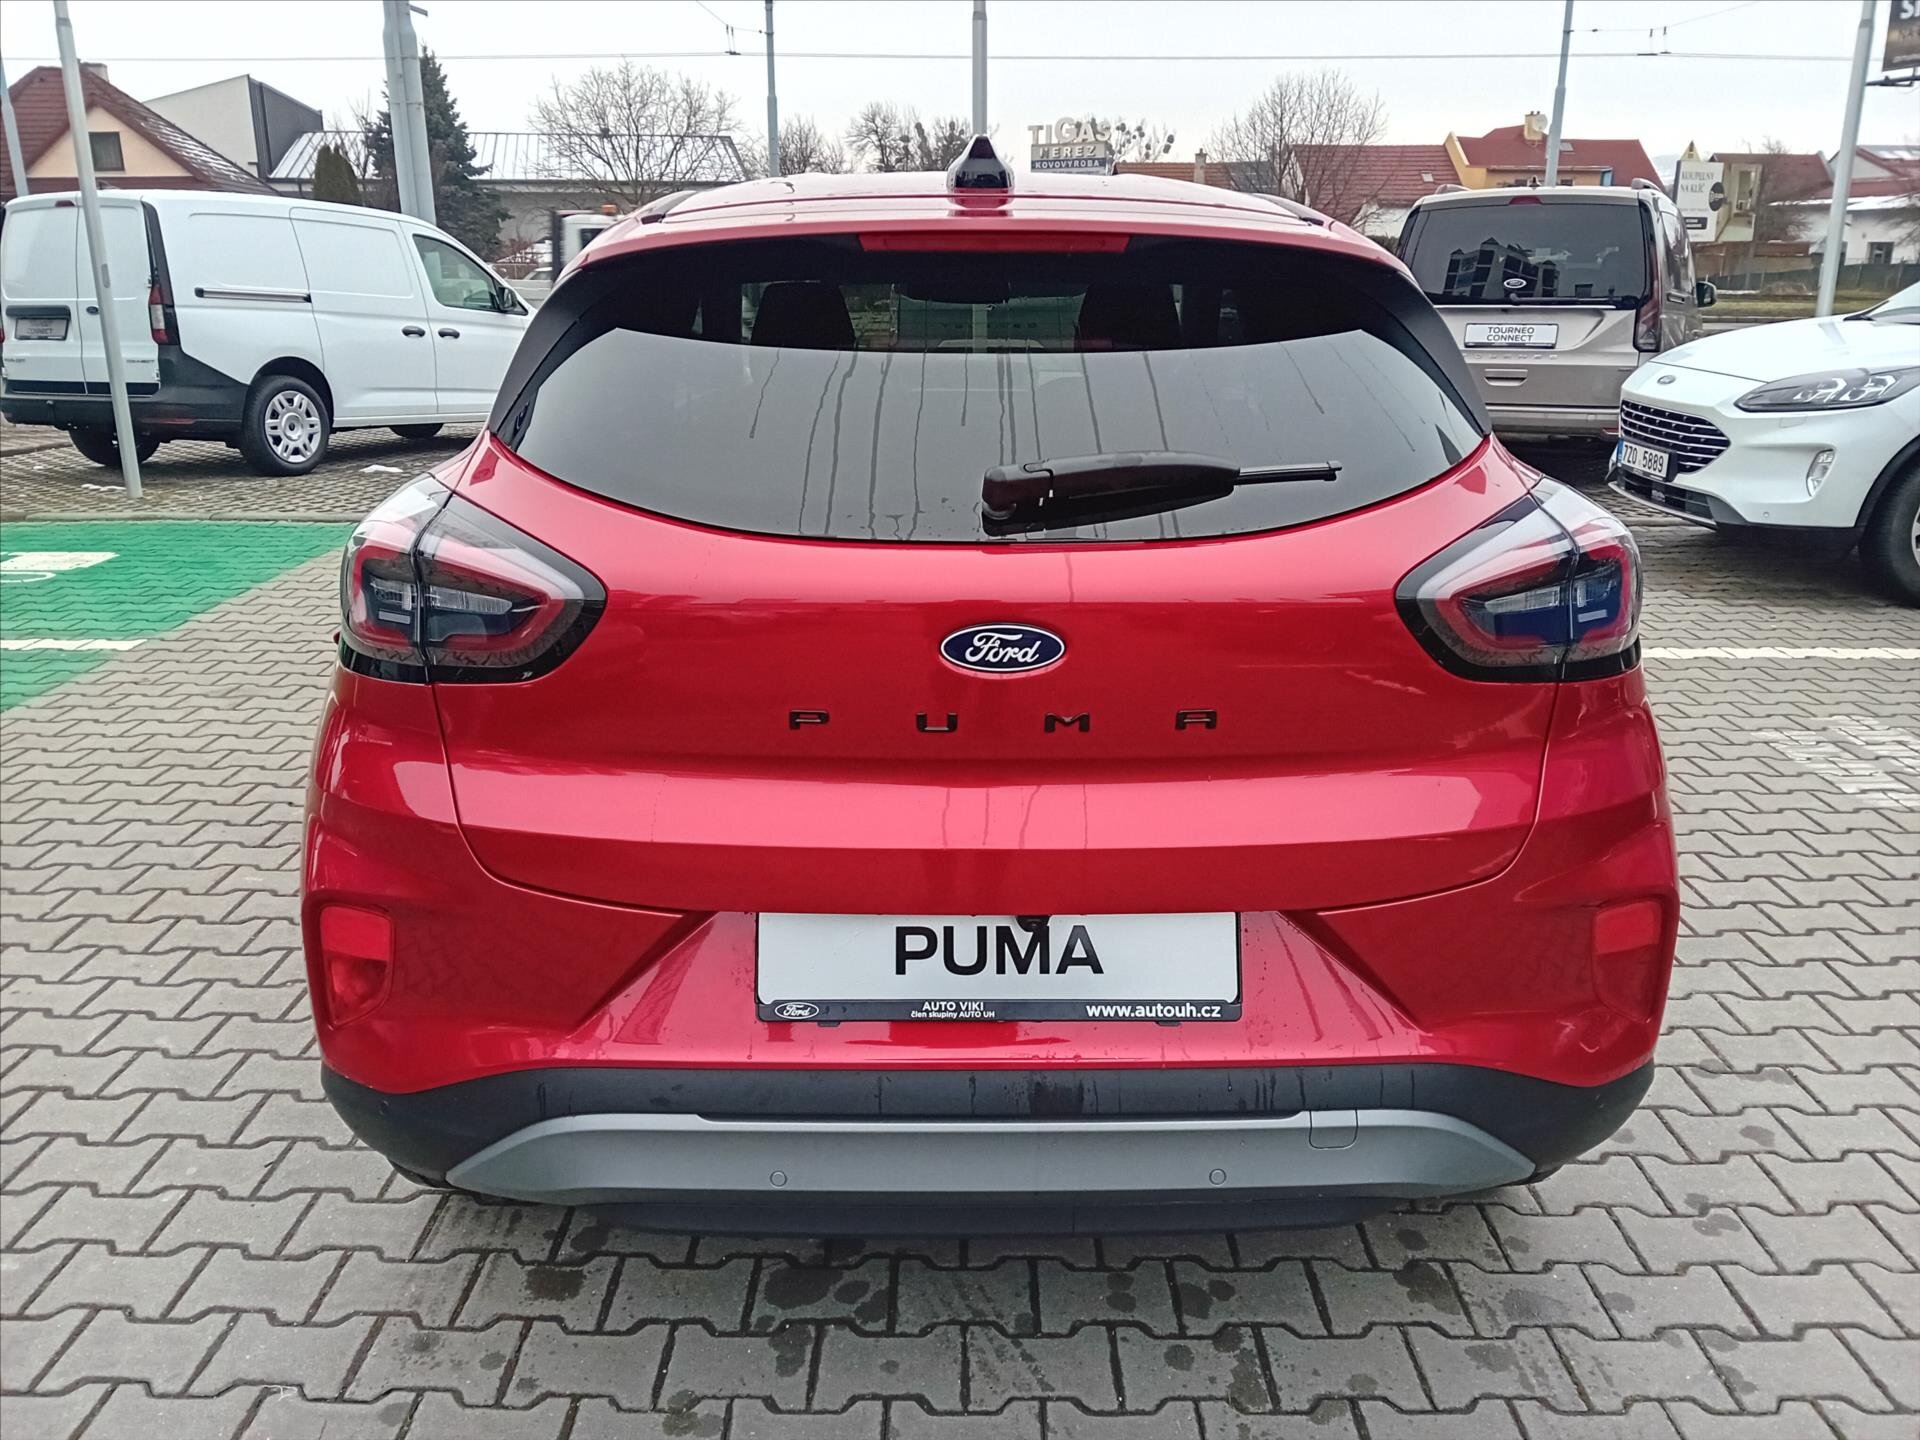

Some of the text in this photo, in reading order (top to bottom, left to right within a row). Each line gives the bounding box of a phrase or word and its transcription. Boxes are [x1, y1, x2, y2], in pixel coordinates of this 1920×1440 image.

[1028, 117, 1111, 144] TIGAS
[1041, 146, 1096, 158] NEREZ
[1488, 326, 1535, 334] TOURNEO
[1487, 334, 1534, 342] CONNECT
[1642, 450, 1664, 473] 5889
[965, 632, 1041, 663] Ford
[789, 708, 1217, 733] PUMA
[895, 925, 1104, 975] PUMA
[783, 1004, 811, 1017] Ford
[922, 1001, 984, 1011] AUTO VIKI
[1086, 1003, 1221, 1017] www.autouh.cz
[911, 1010, 995, 1019] člen skupiny AUTO UH
